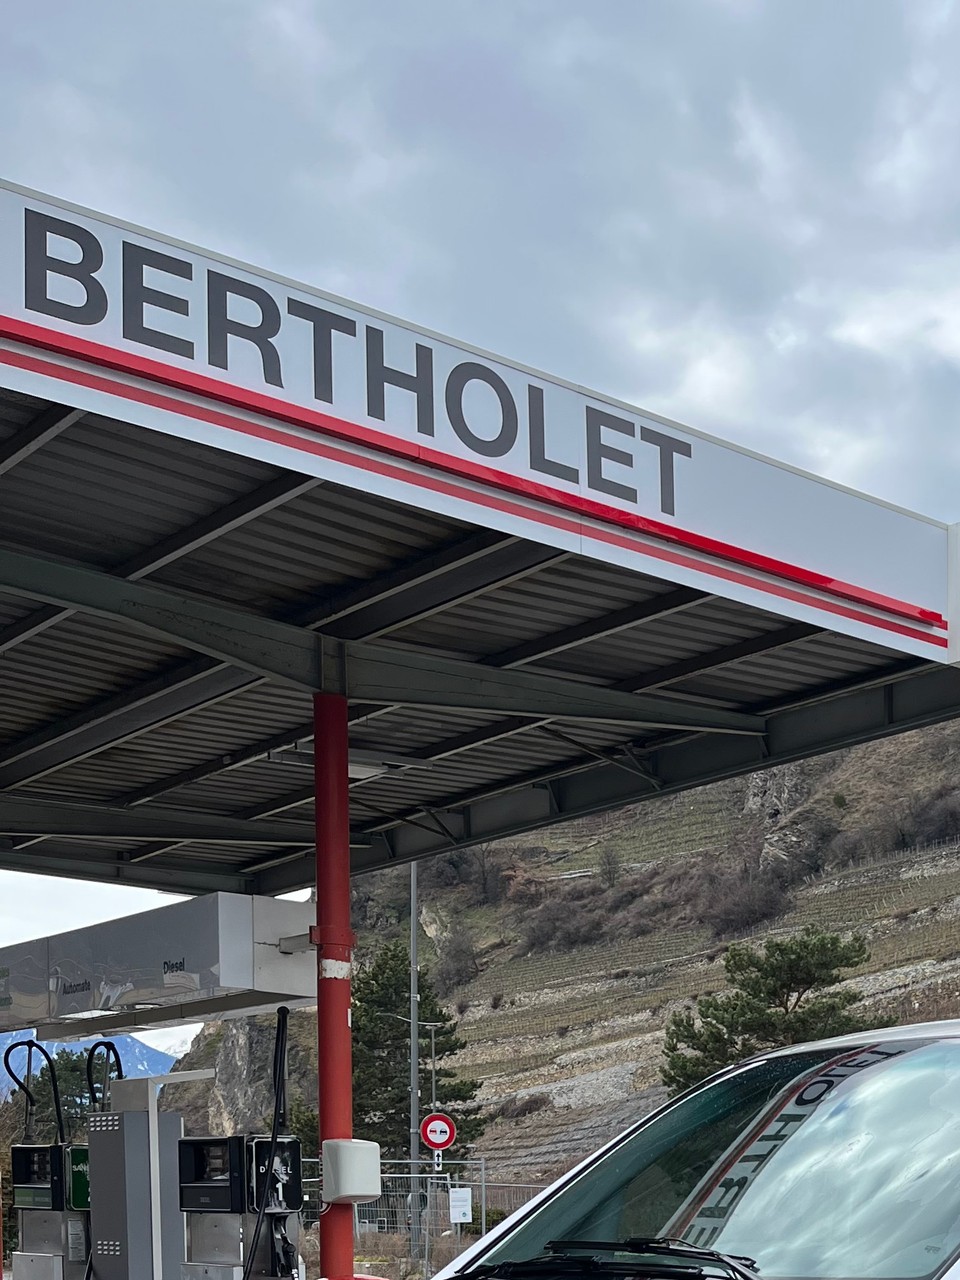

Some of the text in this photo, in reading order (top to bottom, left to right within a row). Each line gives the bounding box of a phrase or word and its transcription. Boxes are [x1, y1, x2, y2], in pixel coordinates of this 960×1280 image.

[24, 207, 693, 517] BERTHOLET
[163, 957, 185, 975] Diesel
[62, 979, 91, 996] Automate
[275, 1181, 284, 1201] 1
